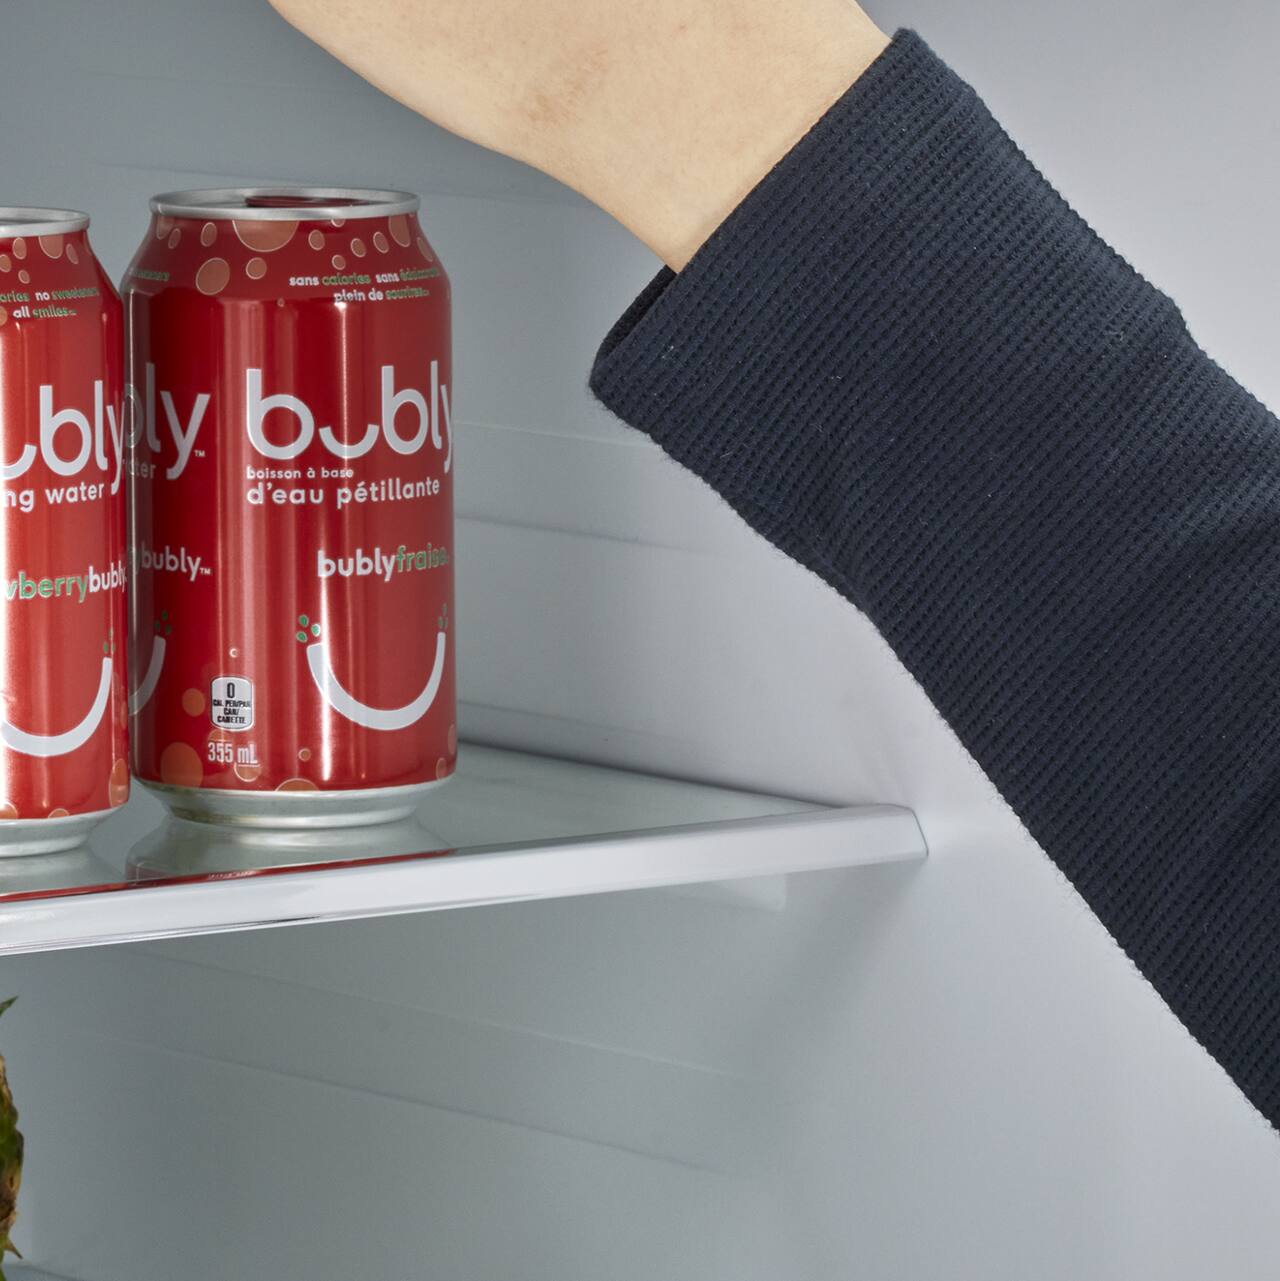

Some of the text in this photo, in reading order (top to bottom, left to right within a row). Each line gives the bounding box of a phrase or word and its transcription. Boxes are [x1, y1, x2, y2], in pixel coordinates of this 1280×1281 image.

[289, 275, 320, 286] sans
[375, 272, 400, 283] sans
[34, 291, 50, 301] no
[333, 289, 366, 303] plein
[12, 305, 31, 319] all
[246, 359, 452, 474] bubly
[246, 465, 354, 479] boisson à base
[45, 481, 105, 505] water
[246, 476, 441, 509] d'eau pétillante
[226, 682, 235, 699] 0
[207, 741, 259, 765] 355 mL
